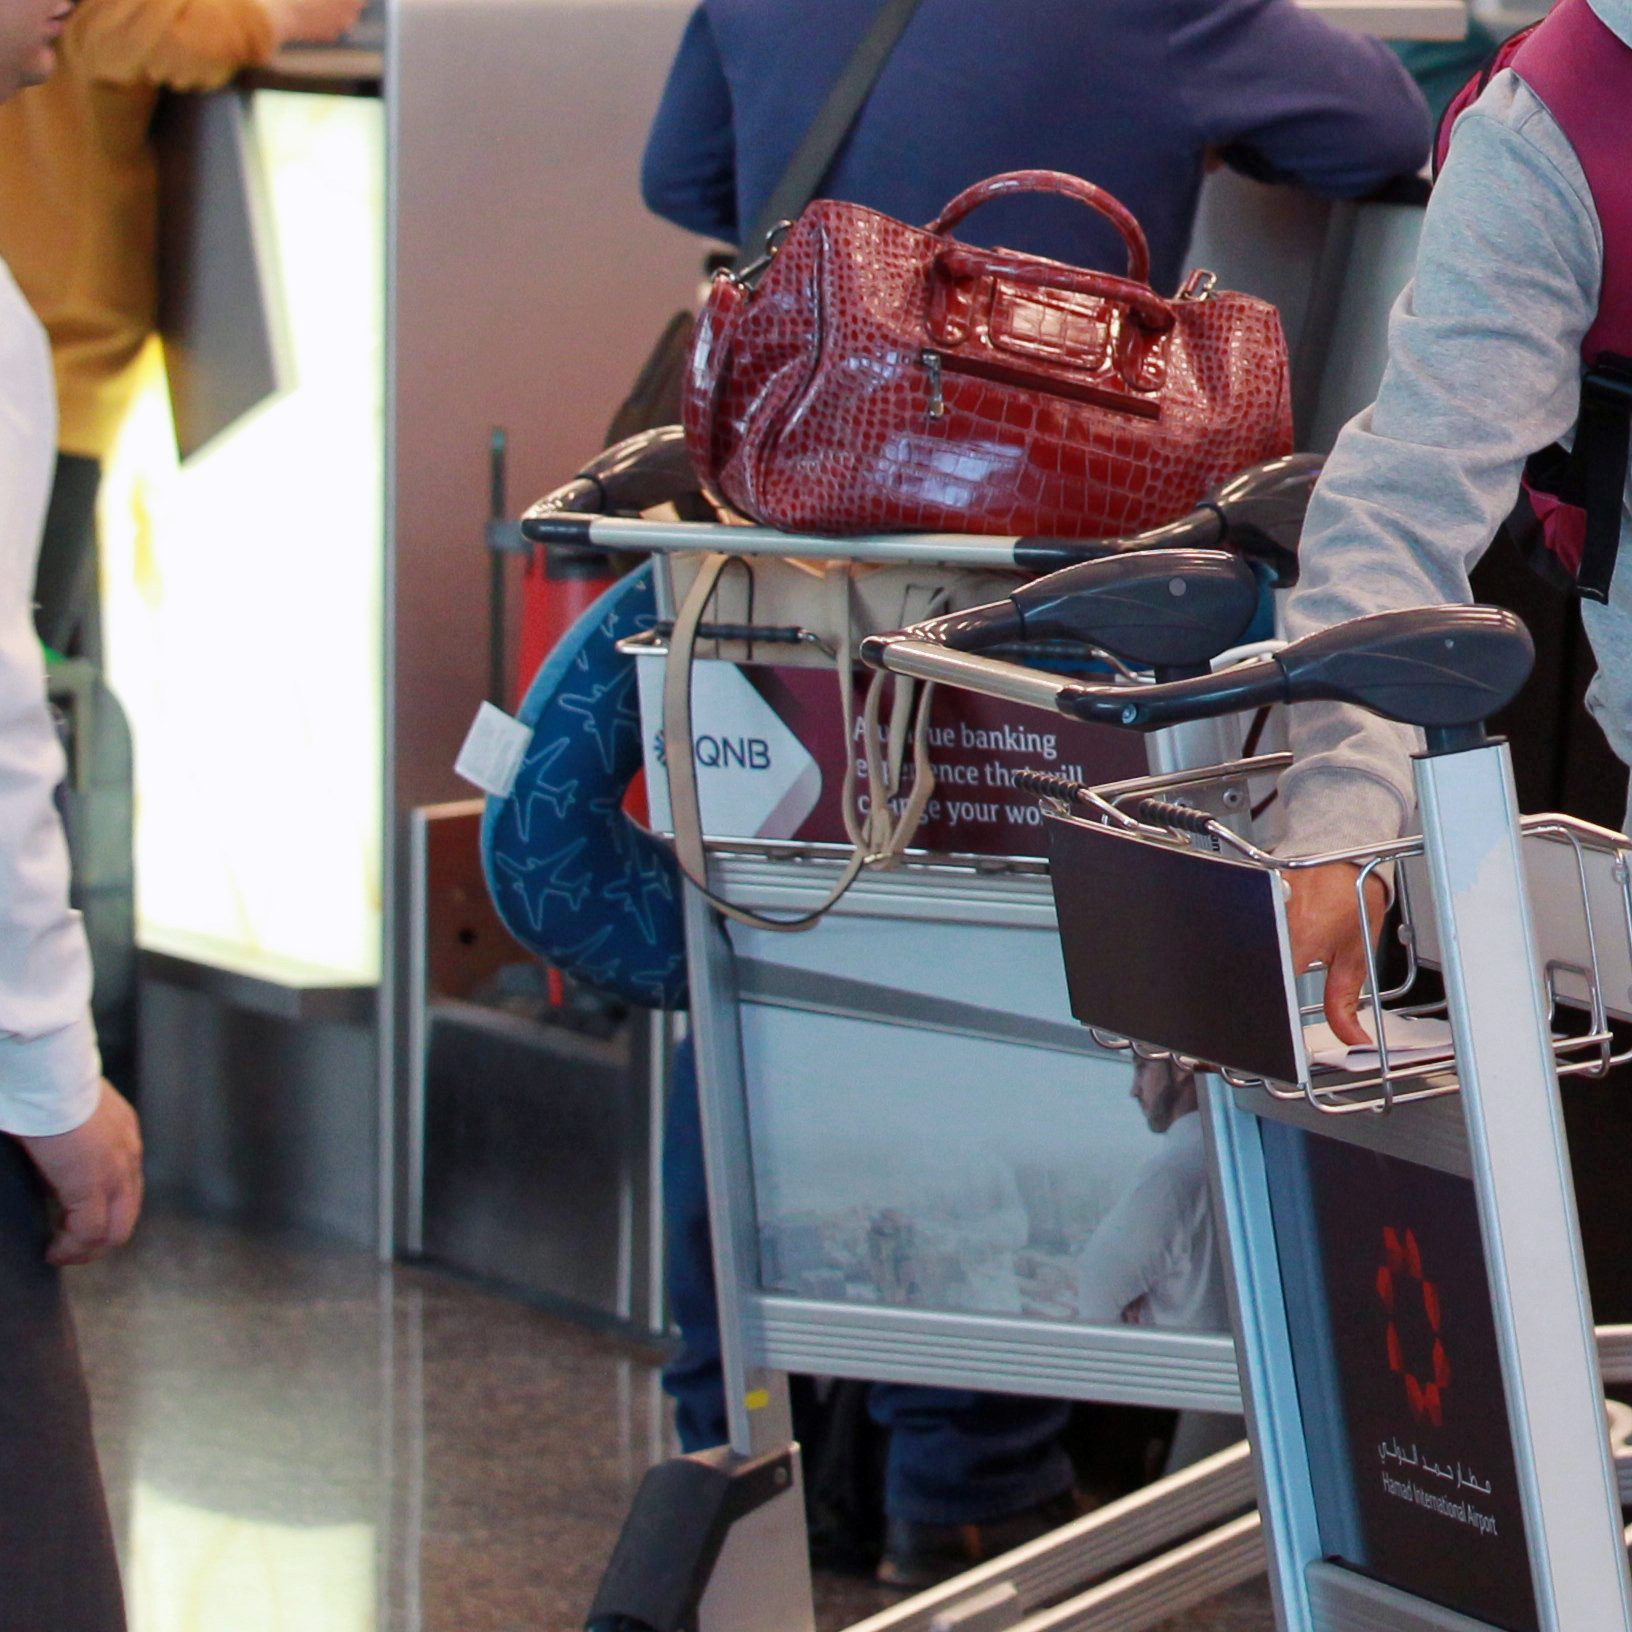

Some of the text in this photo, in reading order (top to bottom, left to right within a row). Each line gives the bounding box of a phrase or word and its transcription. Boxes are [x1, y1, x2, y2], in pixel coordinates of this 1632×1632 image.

[695, 734, 771, 769] QNB
[961, 721, 1058, 760] banking
[947, 801, 1000, 826] your
[1382, 1470, 1499, 1536] Hamad International Airport
